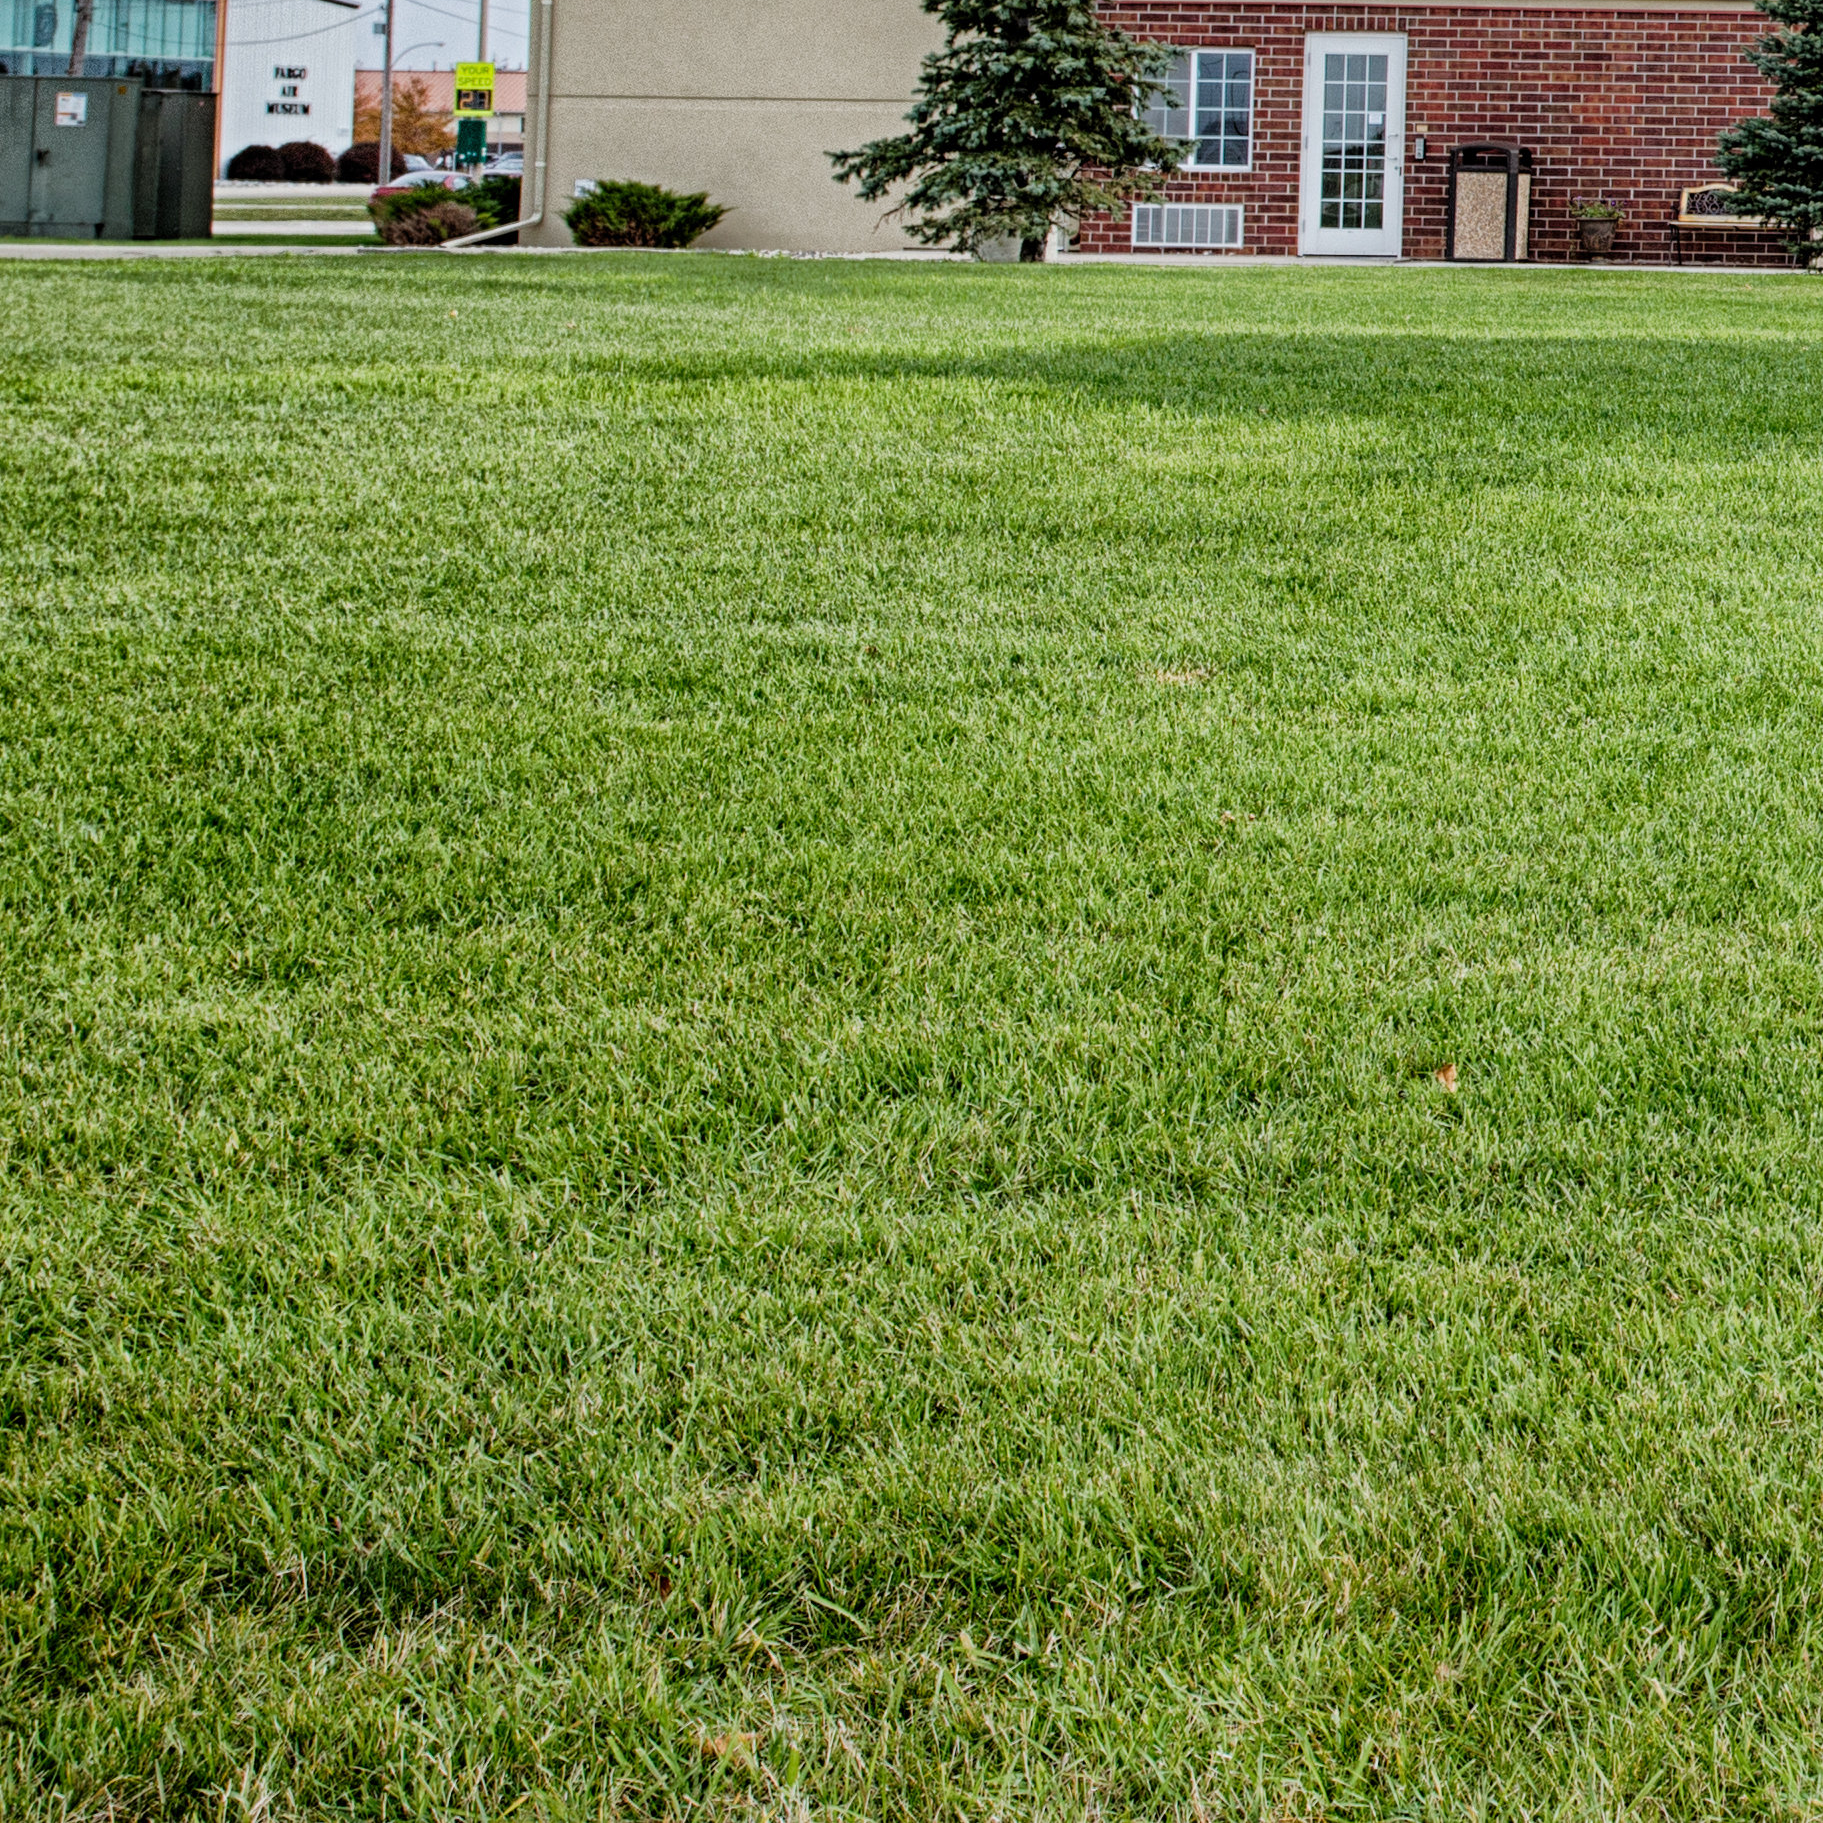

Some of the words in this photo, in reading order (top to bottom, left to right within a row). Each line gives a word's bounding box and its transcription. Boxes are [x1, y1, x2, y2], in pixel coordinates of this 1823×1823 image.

[460, 66, 490, 75] YOUR
[458, 77, 492, 86] SPEED
[266, 102, 310, 115] MUSEUM
